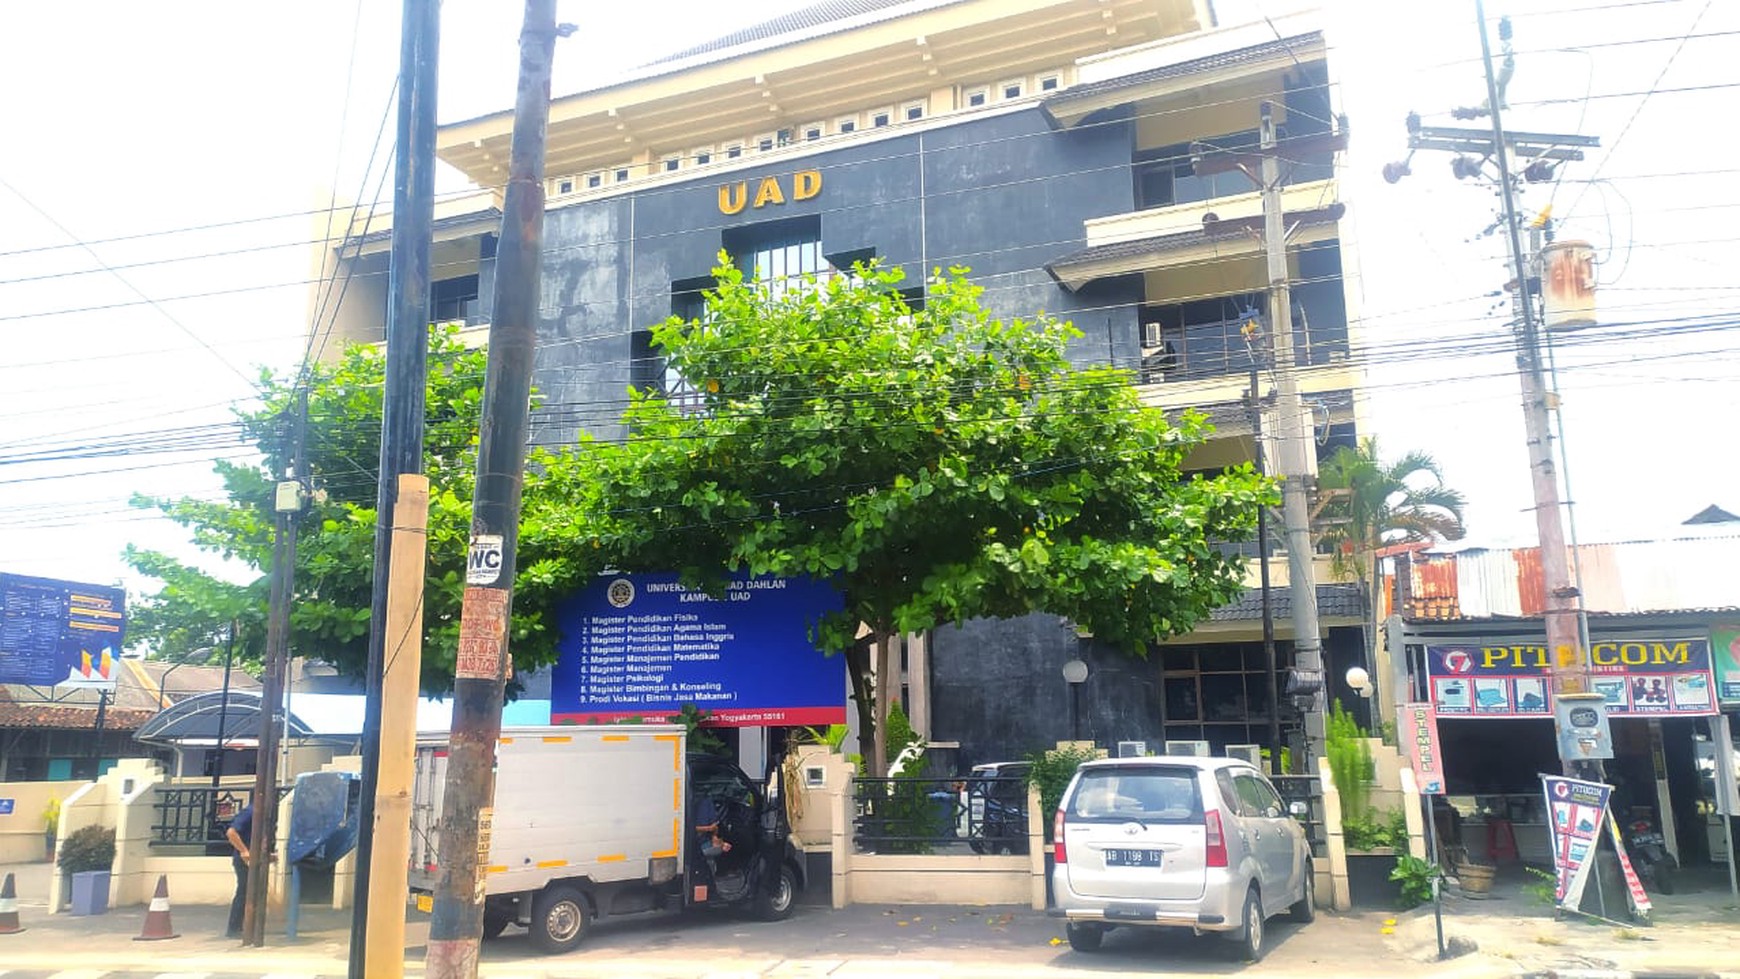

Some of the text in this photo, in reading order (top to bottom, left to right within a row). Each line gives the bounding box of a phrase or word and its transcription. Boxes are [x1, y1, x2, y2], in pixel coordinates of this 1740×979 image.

[718, 169, 822, 215] UAD
[469, 549, 501, 570] WC
[647, 582, 704, 593] UNIVERS
[746, 580, 786, 590] DAHLAN
[730, 591, 751, 601] UAD
[591, 616, 626, 626] Magister
[627, 614, 673, 624] Pendidikan
[673, 613, 698, 622] Fisika
[591, 626, 626, 636] Magister
[627, 624, 672, 633] Pendidikan
[673, 623, 702, 633] Agama
[703, 623, 727, 631] Islam
[590, 636, 626, 646] Magister
[627, 634, 672, 643] Pendidikan
[673, 633, 704, 642] Bahasa
[705, 632, 735, 643] Inggris
[590, 645, 625, 656] Magister
[626, 644, 672, 653] Pendidikan
[673, 642, 720, 652] Matematika
[1480, 642, 1691, 668] PITCOM
[590, 655, 625, 665] Magister
[626, 654, 672, 664] Manajemen
[673, 652, 720, 661] Pendidikan
[590, 665, 625, 675] Magister
[626, 664, 672, 674] Manajemen
[590, 675, 625, 684] Magister
[625, 673, 664, 683] Psikologi
[589, 685, 625, 695] Magister
[625, 684, 670, 693] Bimbingan
[671, 682, 678, 691] &
[680, 682, 722, 691] Konseling
[589, 694, 611, 703] Prodi
[612, 694, 640, 703] Vokasi
[645, 693, 672, 702] Bisnis
[673, 692, 694, 701] Jasa
[695, 691, 732, 701] Makanan
[720, 713, 762, 723] Yogyakarta
[1107, 850, 1117, 861] AB
